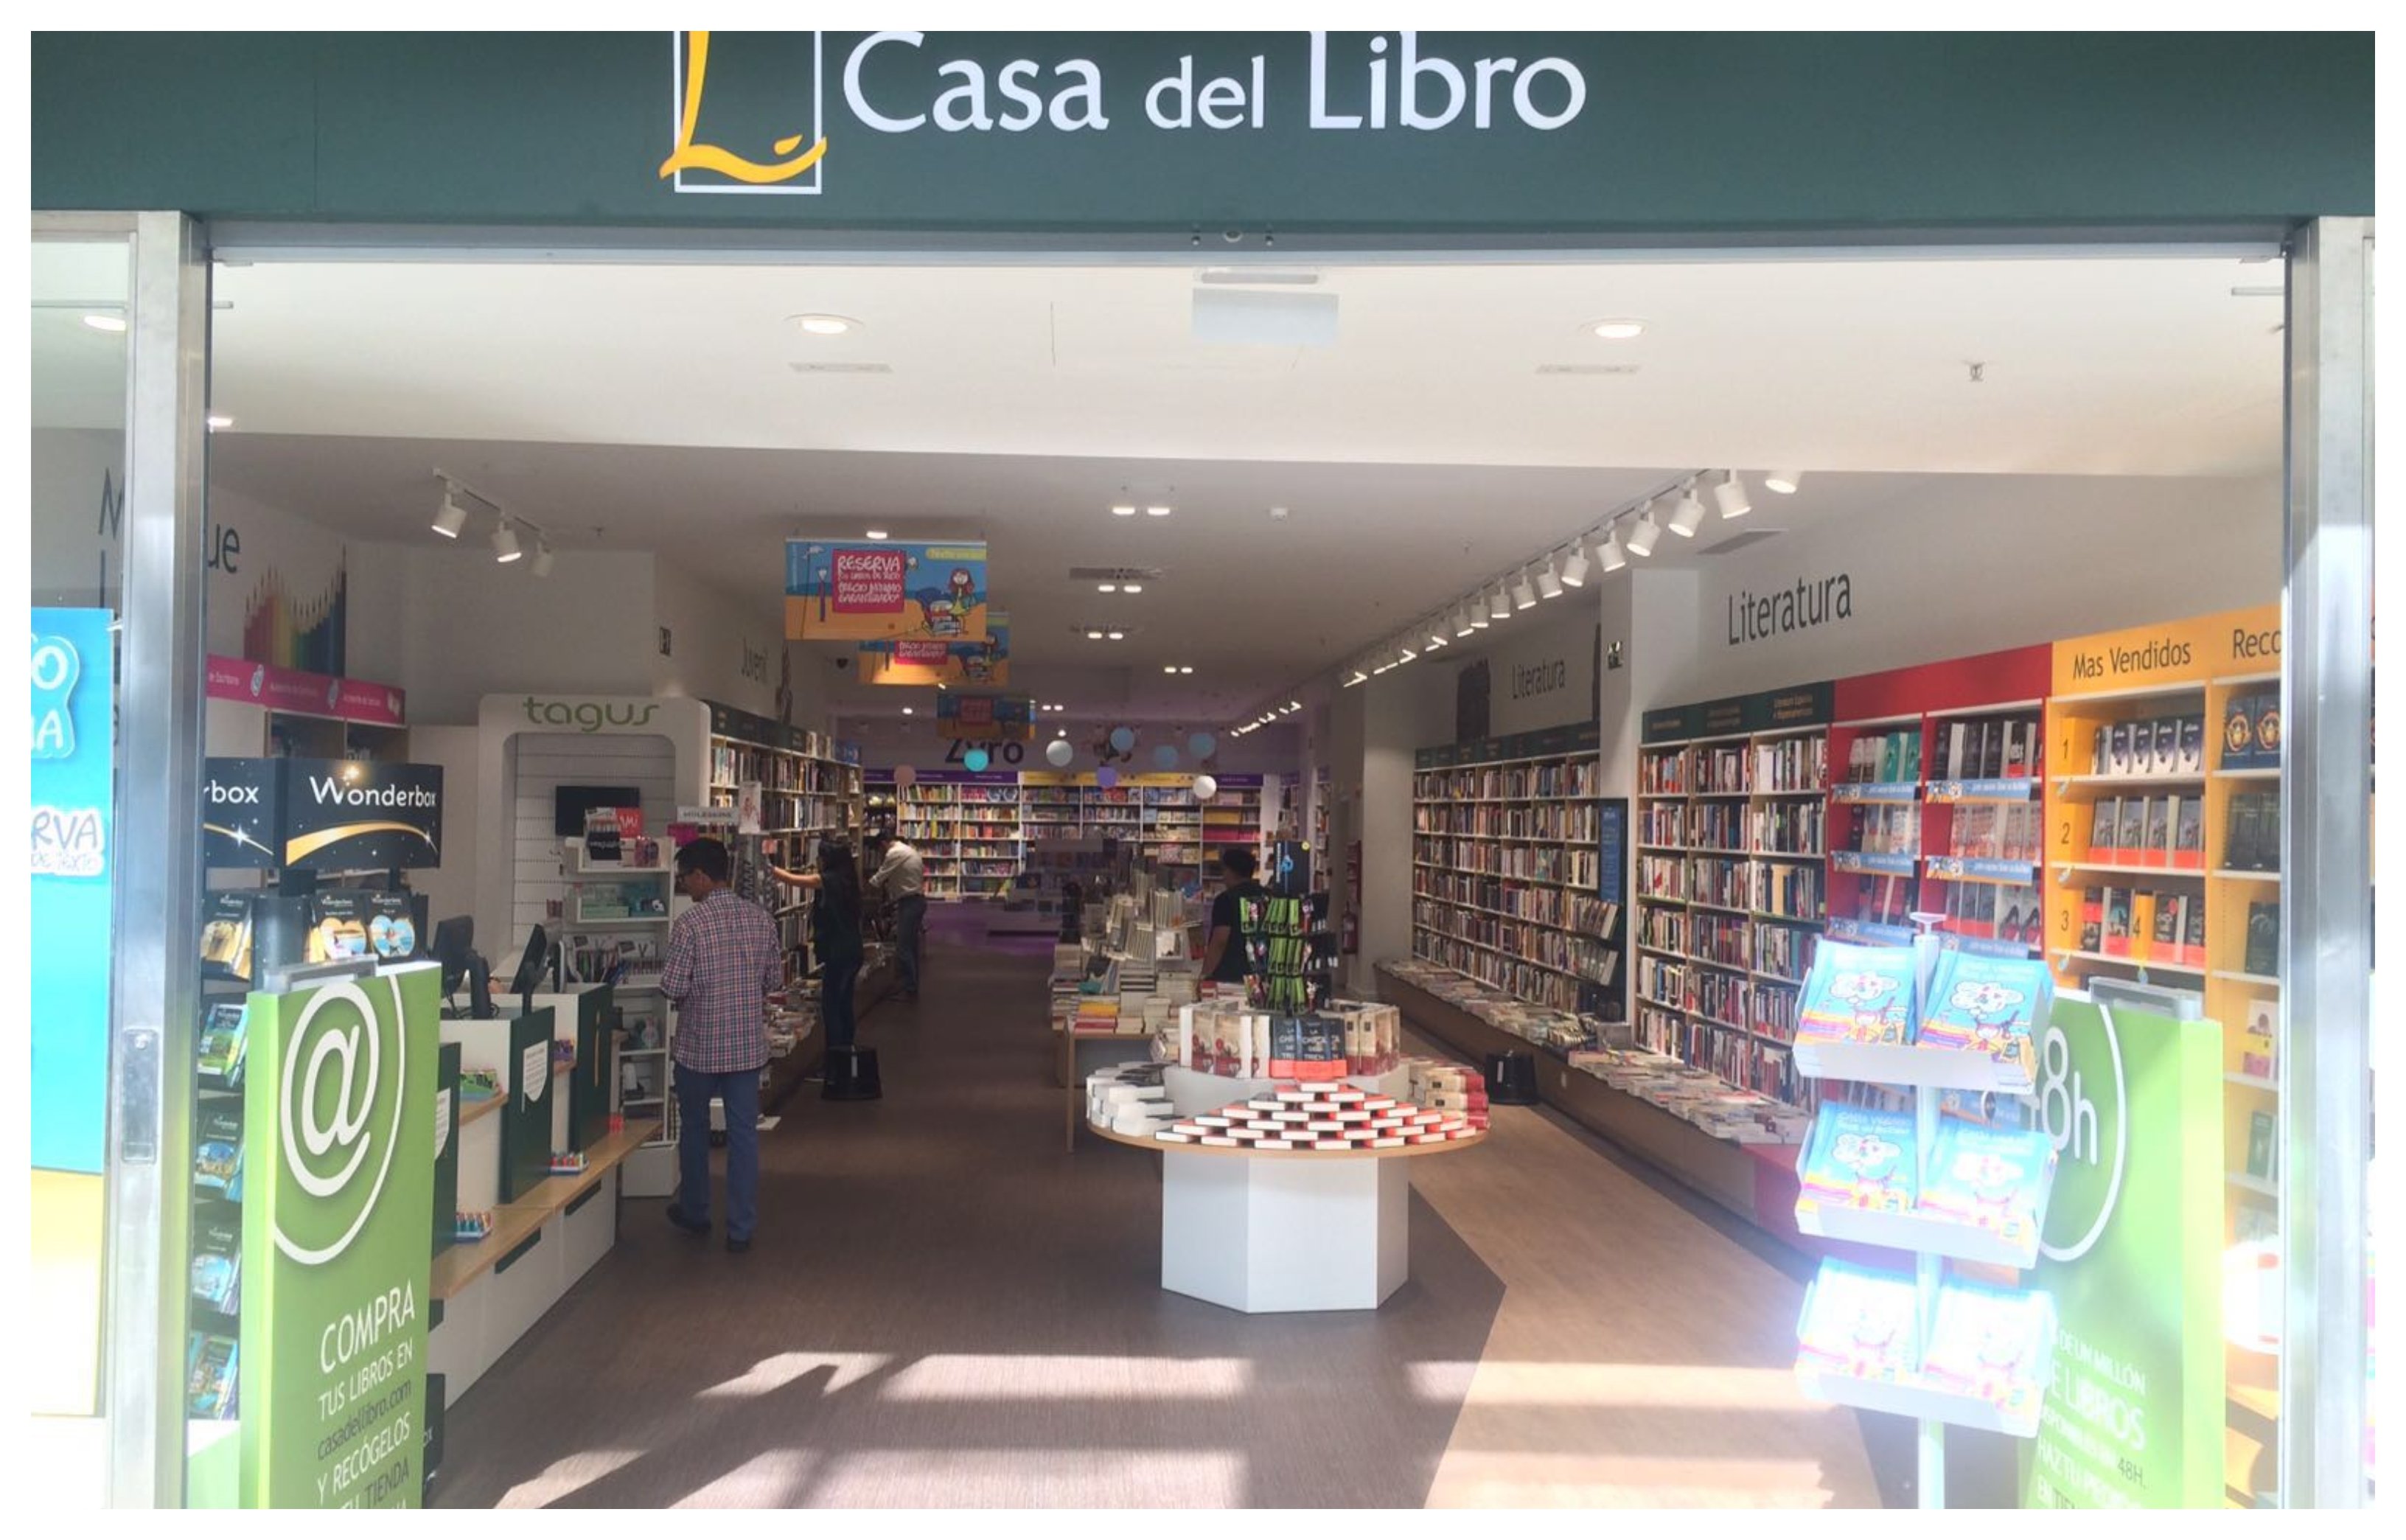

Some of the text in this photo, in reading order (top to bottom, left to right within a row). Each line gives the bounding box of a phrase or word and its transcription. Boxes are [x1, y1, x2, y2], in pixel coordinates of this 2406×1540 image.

[843, 31, 1109, 132] Casa
[1145, 54, 1264, 129] del
[1309, 31, 1586, 130] Libro
[838, 555, 900, 571] RESERVA
[1729, 573, 1852, 645] Literatura
[1511, 658, 1565, 700] Literatura
[2073, 638, 2191, 680] Mas Vendidos
[523, 697, 659, 732] tagus
[2063, 739, 2068, 759] 1
[310, 776, 436, 808] Wonderbox
[2061, 822, 2070, 845] 2
[2061, 910, 2069, 932] 3
[2133, 916, 2141, 936] 4
[2029, 1025, 2098, 1165] 8h
[320, 1278, 415, 1373] COMPRA
[318, 1337, 413, 1421] TUS LIBROS EN
[317, 1379, 412, 1460] casadellibro.com
[317, 1412, 411, 1505] Y RECÓGELOS
[2117, 1456, 2146, 1490] 48H.
[365, 1457, 410, 1508] TIENDA
